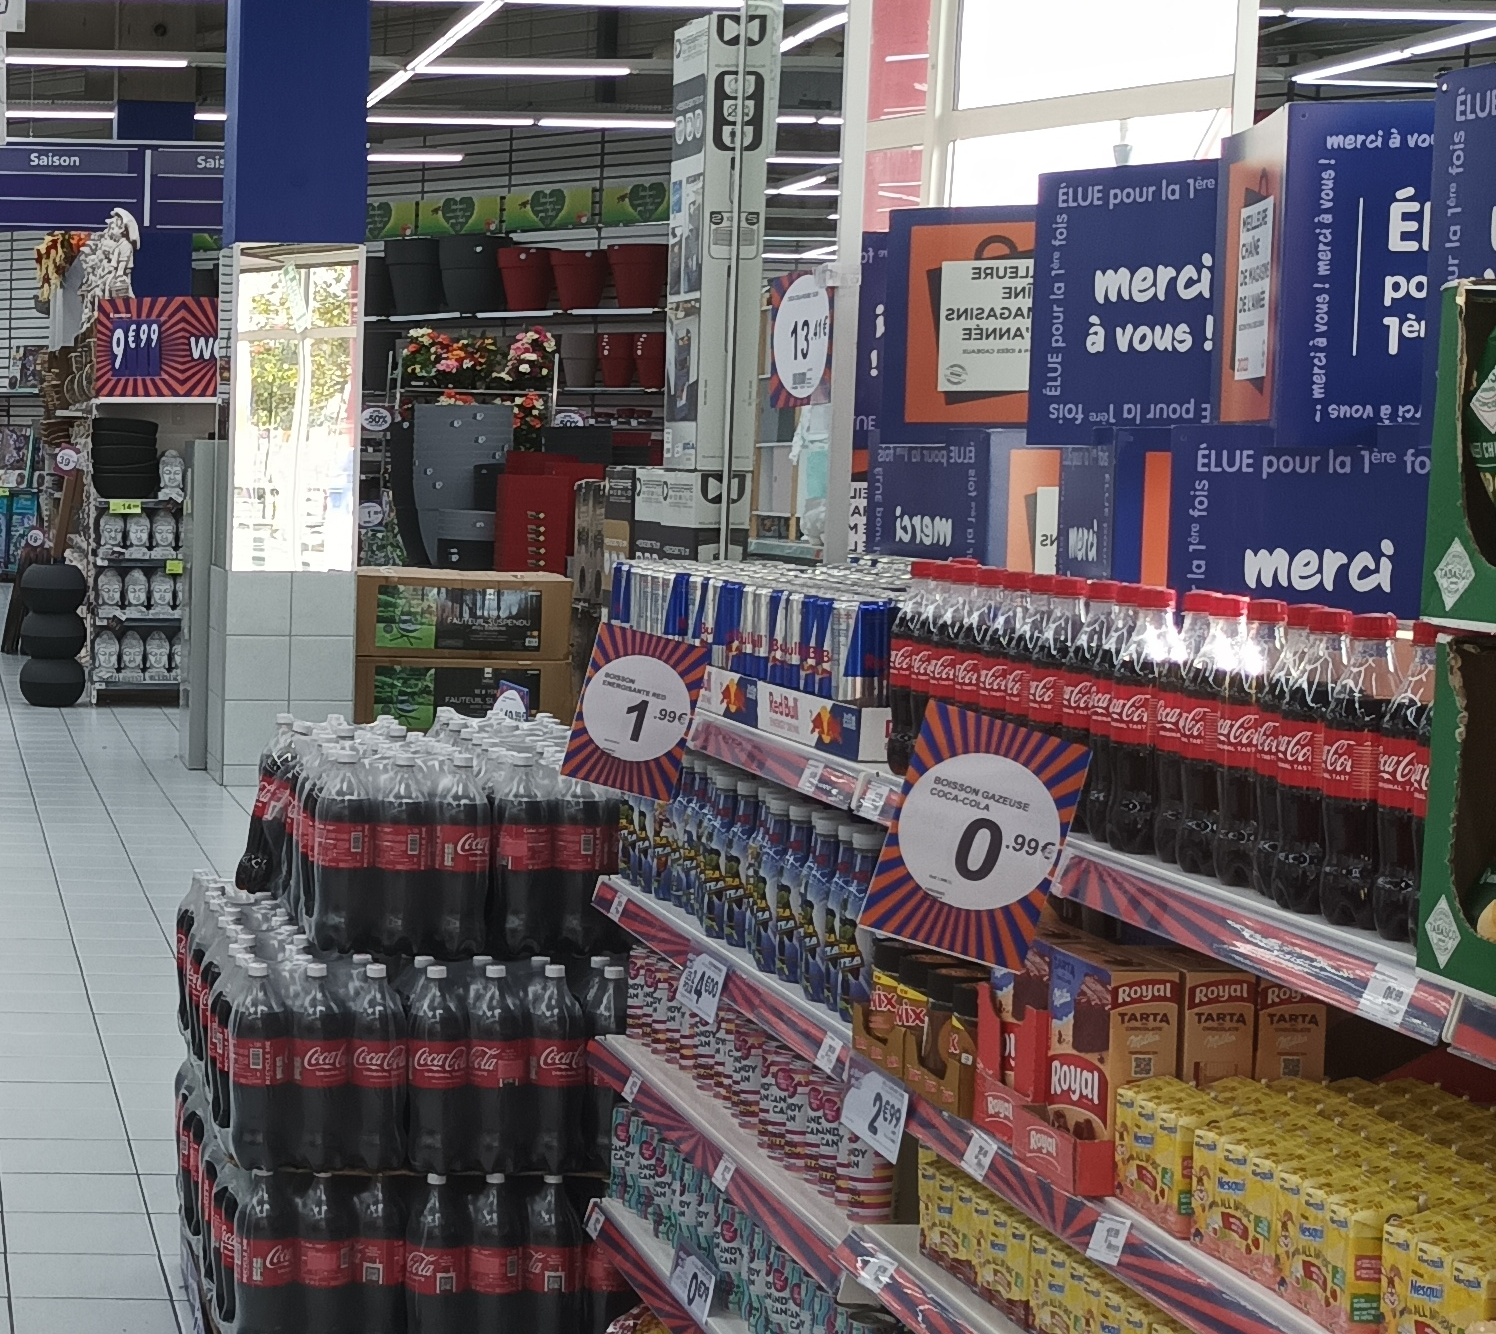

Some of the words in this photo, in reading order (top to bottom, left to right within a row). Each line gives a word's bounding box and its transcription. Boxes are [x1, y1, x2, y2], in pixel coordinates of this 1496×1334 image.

[1326, 130, 1383, 150] merci
[1388, 128, 1400, 148] à
[1449, 130, 1466, 176] fois
[29, 152, 80, 168] Saison
[1057, 183, 1102, 208] ÉLUE
[1109, 182, 1159, 210] pour
[1162, 179, 1181, 202] la
[1186, 176, 1217, 200] 1ère
[1320, 169, 1336, 209] vous
[1053, 212, 1069, 244] fois
[1315, 214, 1333, 224] à
[1445, 225, 1462, 248] la
[1315, 229, 1332, 276] merci
[1050, 280, 1065, 304] la
[1093, 252, 1212, 304] merci
[1315, 294, 1330, 333] vous
[1049, 308, 1067, 352] pour
[1085, 317, 1105, 354] à
[1115, 317, 1193, 354] vous
[1309, 338, 1327, 348] à
[110, 323, 161, 370] 9€99
[1043, 354, 1063, 398] ÉLUE
[1312, 353, 1327, 399] merci
[1196, 444, 1255, 473] ÉLUE
[1261, 449, 1320, 479] pour
[1327, 448, 1351, 474] la
[1359, 448, 1397, 474] 1ère
[1243, 538, 1395, 594] merci
[447, 617, 485, 626] FAUTEUIL
[601, 679, 651, 696] ENERGISANTE
[652, 690, 667, 701] RED
[603, 672, 636, 686] BOISSON
[929, 787, 991, 813] COCA-COLA
[933, 775, 980, 799] BOISSON
[981, 789, 1031, 812] GAZEUSE
[1117, 982, 1172, 1004] Royal
[1194, 981, 1249, 1004] Royal
[1117, 1012, 1171, 1026] TARTA
[1194, 1013, 1248, 1027] TARTA
[1266, 1013, 1319, 1027] TARTA
[1051, 1060, 1099, 1104] Royal
[868, 1092, 901, 1136] 2€99
[987, 1096, 1013, 1120] Royal
[1029, 1127, 1058, 1157] Royal
